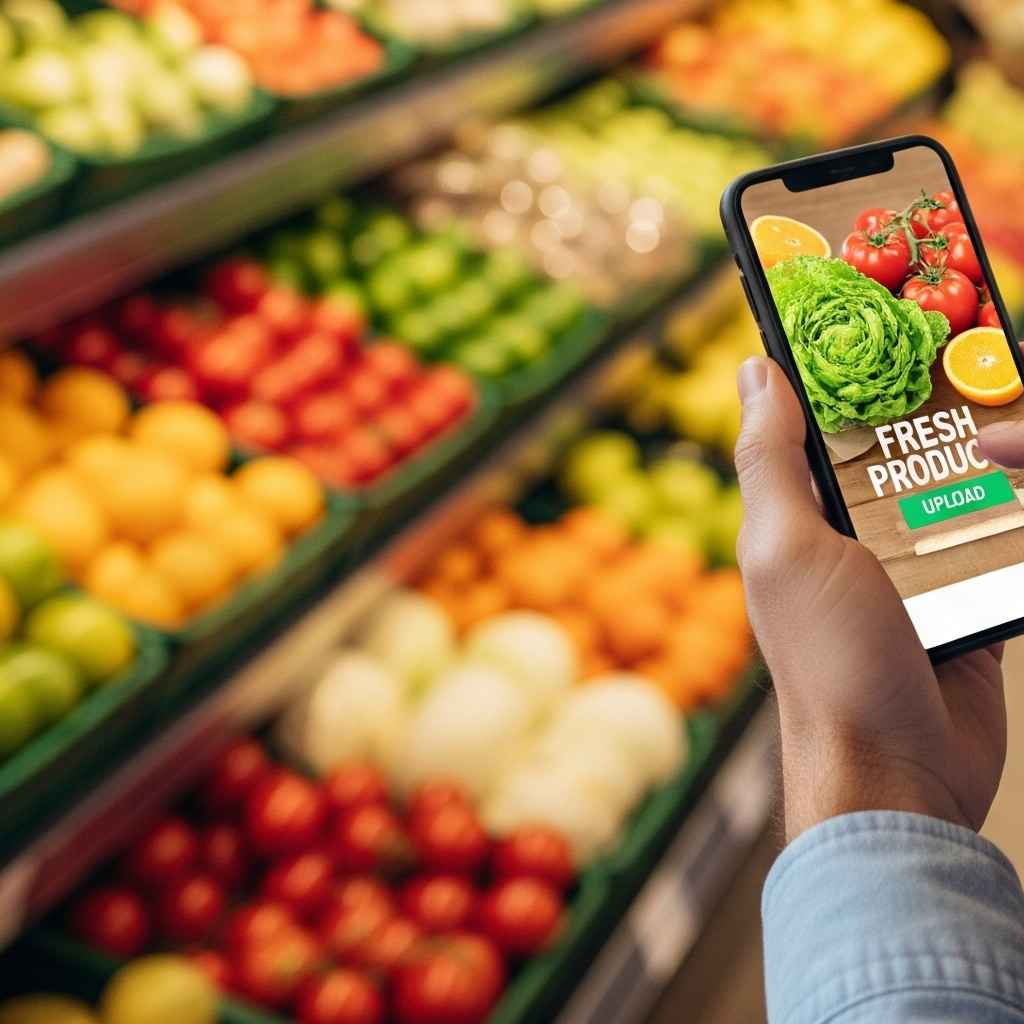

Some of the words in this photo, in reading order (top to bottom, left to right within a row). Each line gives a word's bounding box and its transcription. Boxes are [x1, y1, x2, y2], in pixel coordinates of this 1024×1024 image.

[875, 406, 978, 459] FRESH
[866, 439, 989, 497] PRODUC
[922, 486, 986, 514] UPLOAD
